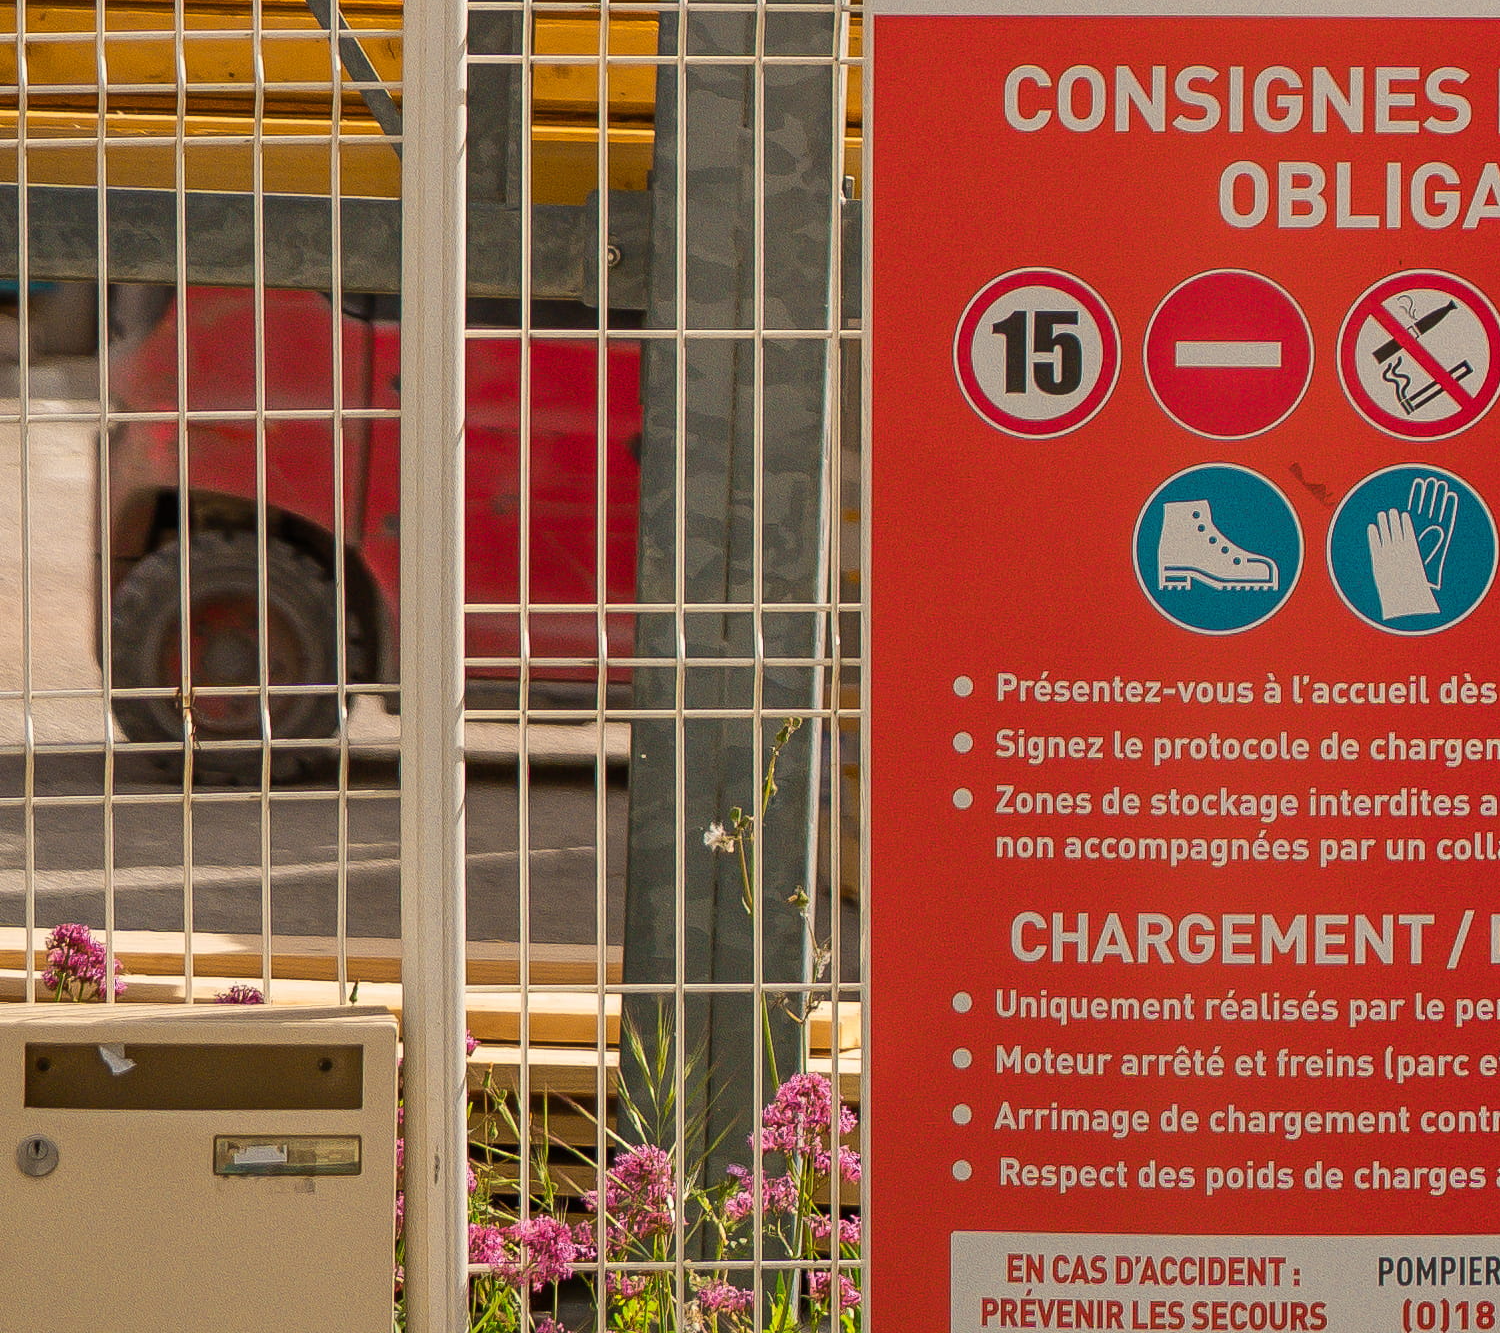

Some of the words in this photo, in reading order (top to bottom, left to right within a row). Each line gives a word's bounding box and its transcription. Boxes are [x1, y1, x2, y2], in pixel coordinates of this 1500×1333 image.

[1004, 65, 1471, 134] CONSIGNES
[991, 307, 1082, 396] 15
[998, 671, 1253, 703] Présentez-vous
[1264, 673, 1281, 703] à
[1440, 674, 1497, 704] dès
[996, 729, 1103, 765] Signez
[1114, 731, 1143, 759] le
[1154, 732, 1309, 766] protocole
[1321, 732, 1359, 760] de
[996, 785, 1092, 814] Zones
[1102, 787, 1140, 815] de
[1151, 788, 1298, 823] stockage
[1310, 788, 1470, 816] interdites
[997, 837, 1054, 858] non
[1065, 830, 1309, 867] accompagnées
[1321, 839, 1375, 867] par
[1386, 839, 1425, 860] un
[1011, 912, 1434, 964] CHARGEMENT
[1447, 910, 1474, 969] /
[996, 990, 1194, 1025] Uniquement
[1206, 990, 1338, 1021] réalisés
[1350, 1000, 1405, 1027] par
[1415, 993, 1444, 1020] le
[997, 1045, 1112, 1075] Moteur
[1121, 1046, 1224, 1076] arrêté
[1235, 1051, 1266, 1076] et
[1277, 1049, 1374, 1077] freins
[1385, 1046, 1469, 1084] (parc
[994, 1102, 1149, 1138] Arrimage
[1161, 1104, 1199, 1132] de
[1210, 1105, 1409, 1140] chargement
[1001, 1158, 1127, 1193] Respect
[1138, 1160, 1195, 1188] des
[1207, 1161, 1294, 1195] poids
[1305, 1161, 1343, 1189] de
[1354, 1161, 1486, 1196] charges
[1007, 1254, 1044, 1283] EN
[1052, 1255, 1107, 1285] CAS
[1292, 1269, 1300, 1287] :
[981, 1290, 1123, 1329] PRÉVENIR
[1131, 1301, 1184, 1331] LES
[1192, 1302, 1326, 1331] SECOURS
[1402, 1300, 1494, 1333] (0)18
